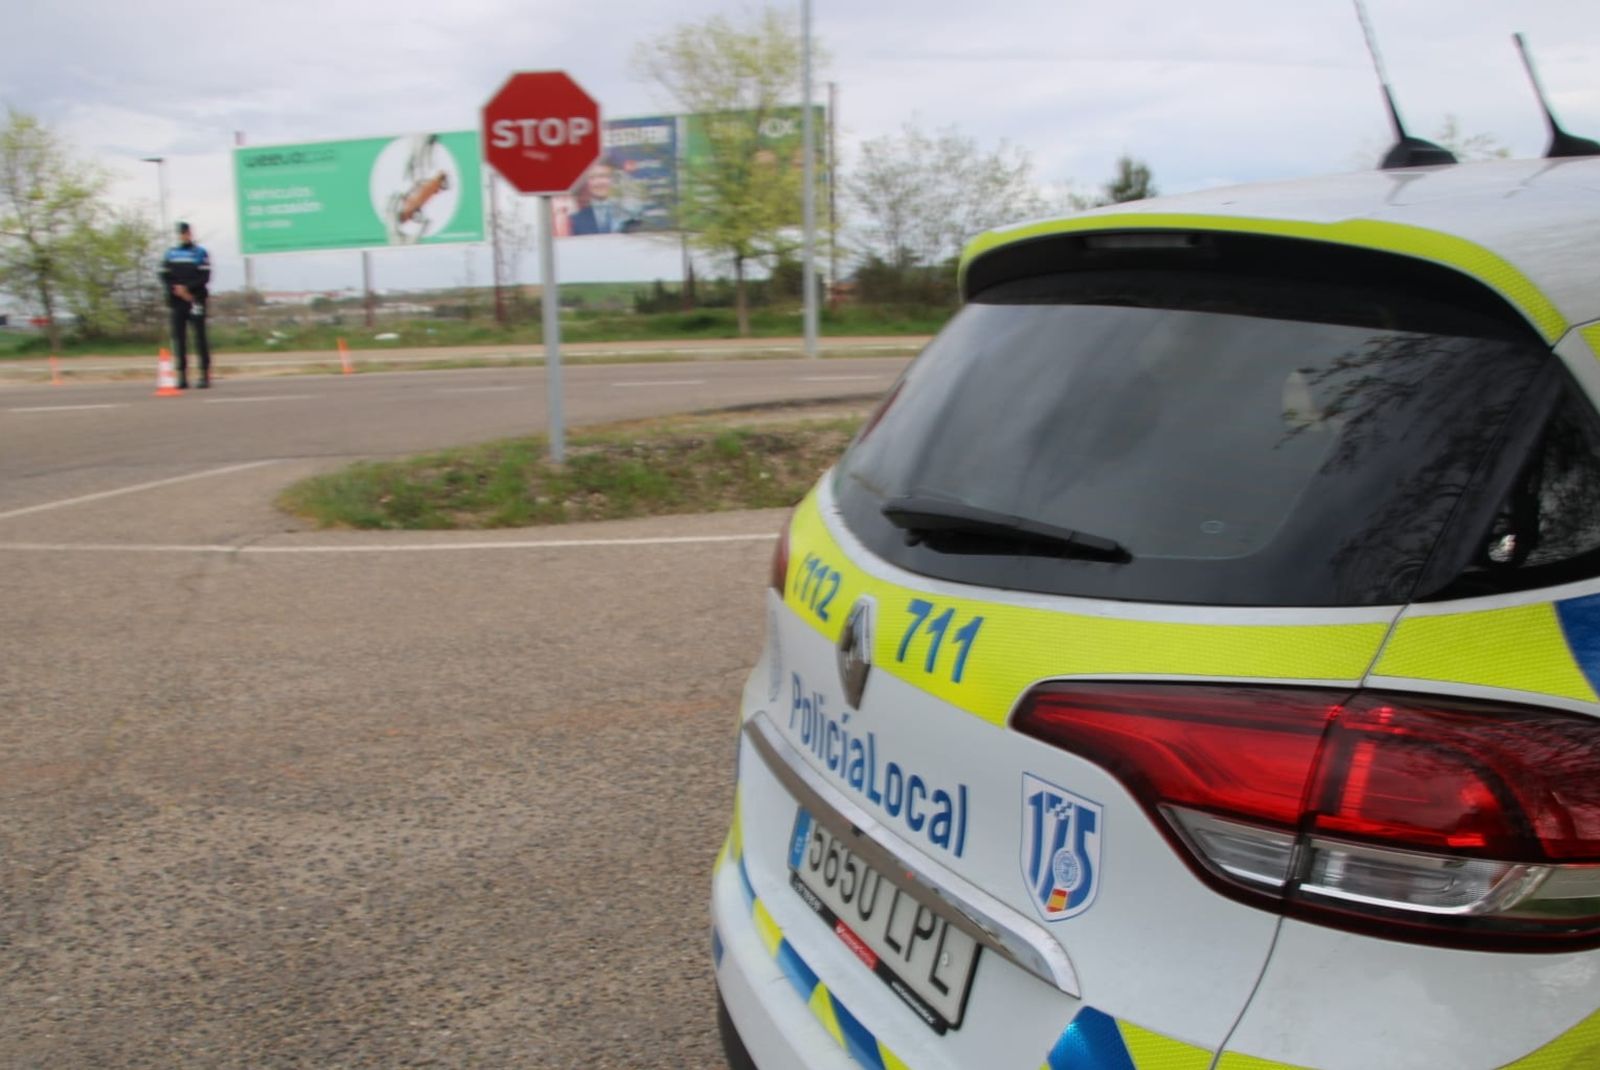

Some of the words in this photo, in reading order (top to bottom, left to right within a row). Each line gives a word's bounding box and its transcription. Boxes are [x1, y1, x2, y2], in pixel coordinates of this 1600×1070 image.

[491, 116, 593, 148] STOP
[896, 598, 985, 683] 711
[809, 824, 881, 922] 5650
[884, 887, 949, 997] LPL
